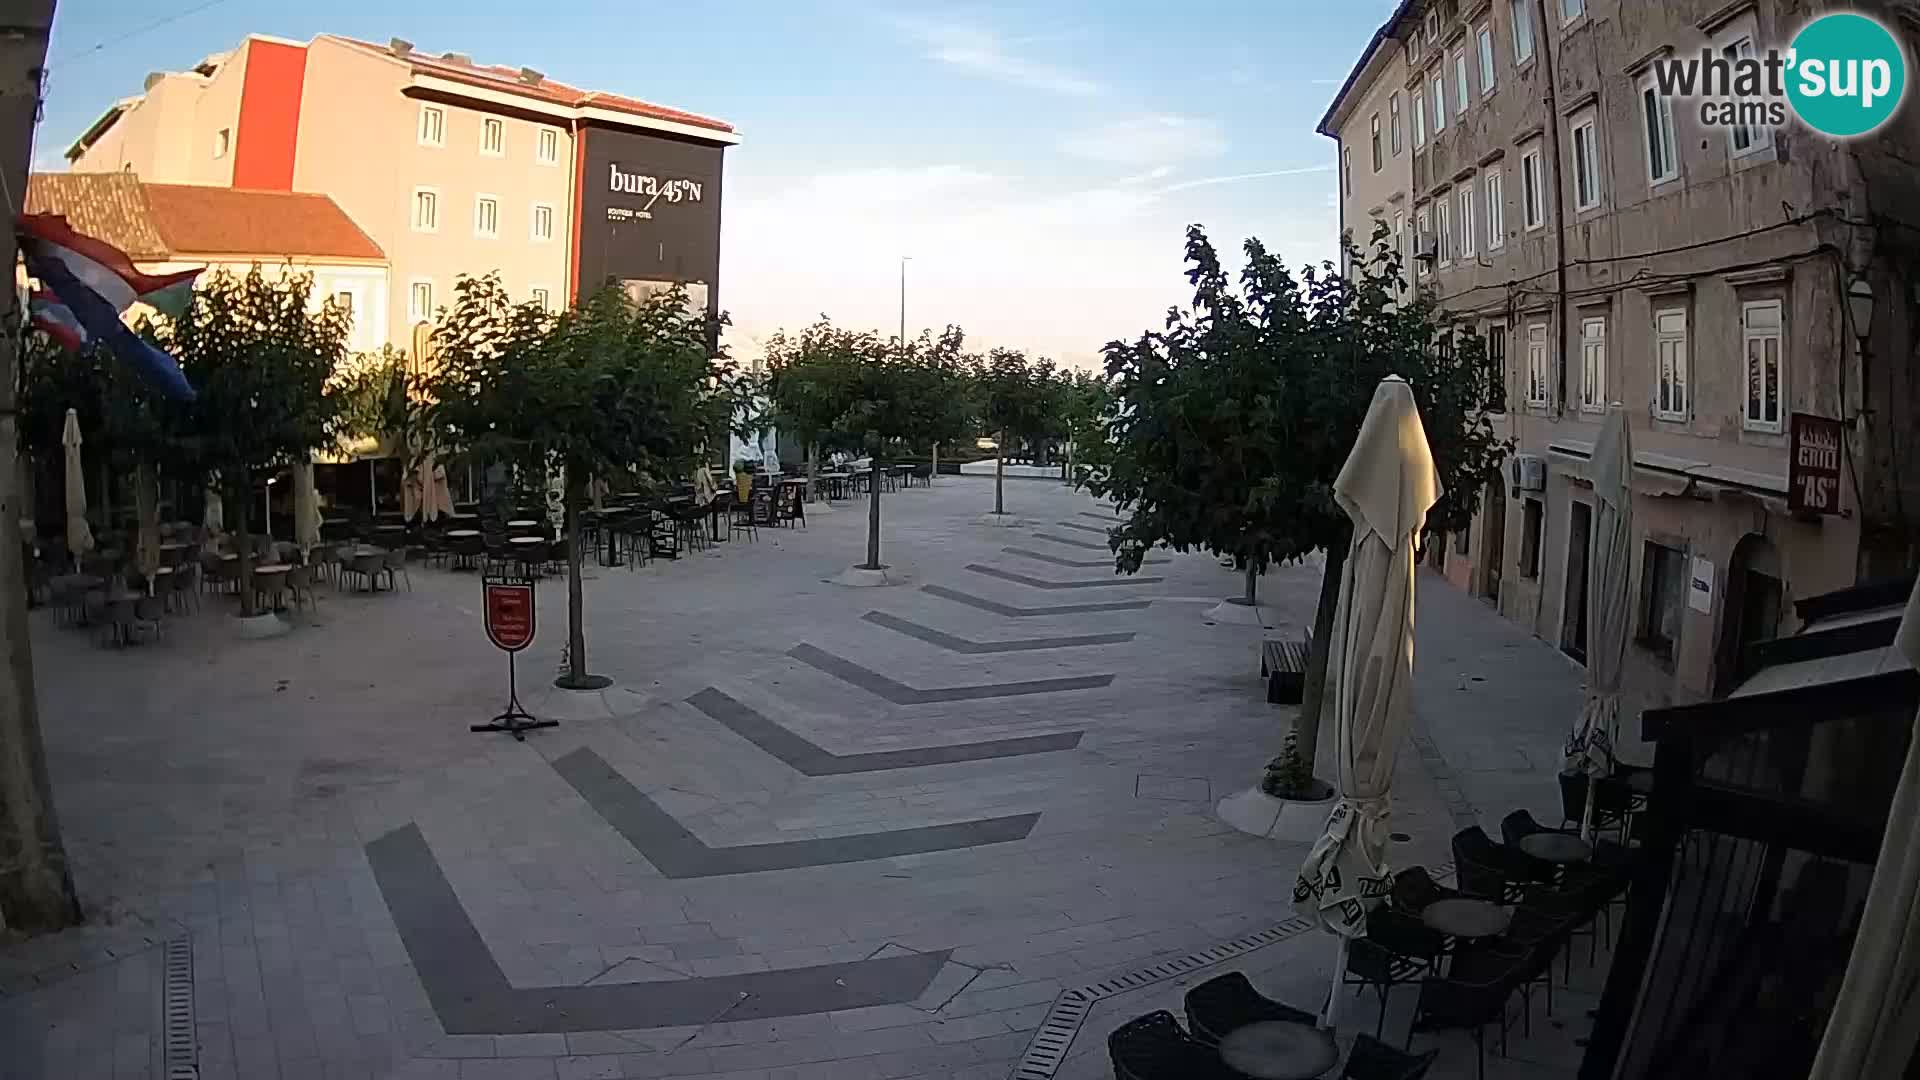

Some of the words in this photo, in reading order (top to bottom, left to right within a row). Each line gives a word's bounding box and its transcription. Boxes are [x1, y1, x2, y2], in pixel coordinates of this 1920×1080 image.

[610, 163, 657, 196] bura
[635, 211, 652, 219] HOTEL
[1798, 447, 1838, 470] GRILL
[485, 577, 504, 585] WINE
[506, 577, 523, 585] BAR
